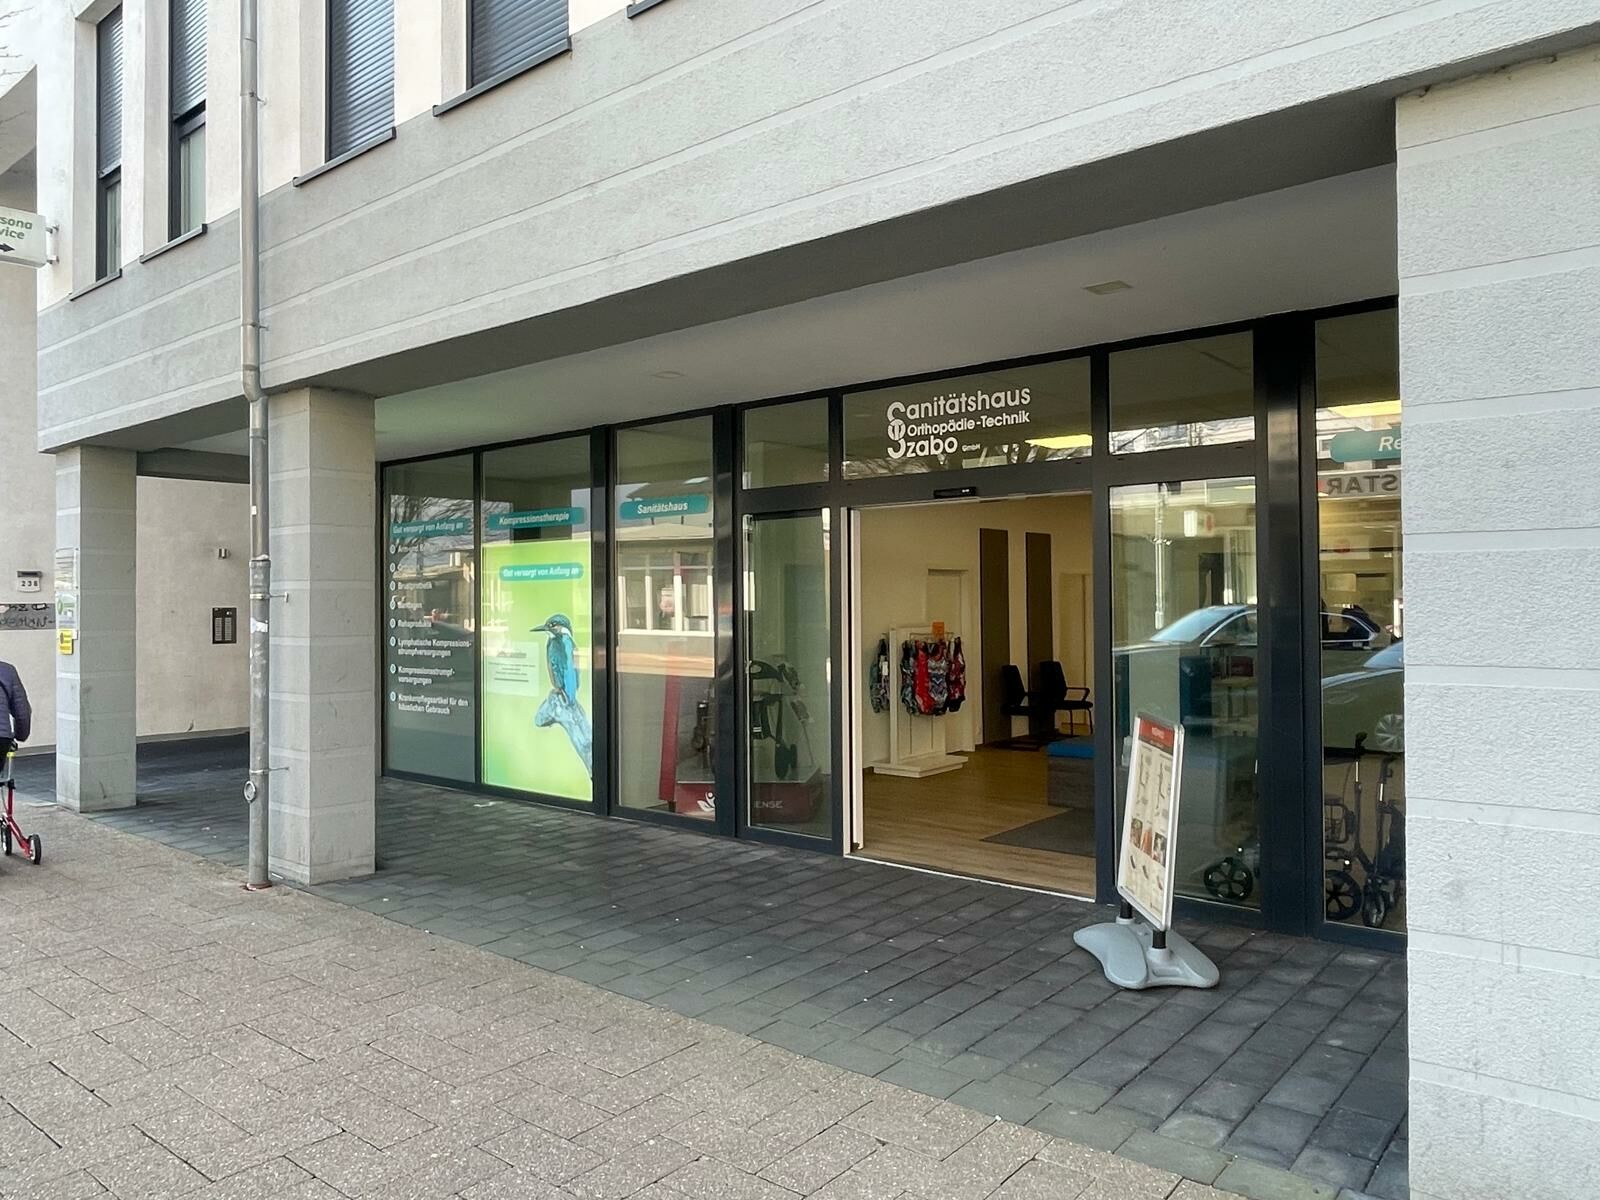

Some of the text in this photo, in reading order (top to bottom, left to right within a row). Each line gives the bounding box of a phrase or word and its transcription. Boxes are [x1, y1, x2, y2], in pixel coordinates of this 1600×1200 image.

[887, 388, 1031, 421] Sanitätshaus
[907, 410, 1030, 437] Orthopädie-Technik
[887, 435, 958, 459] Szabo
[962, 444, 981, 452] GmbH
[637, 502, 689, 514] Sanitätshaus
